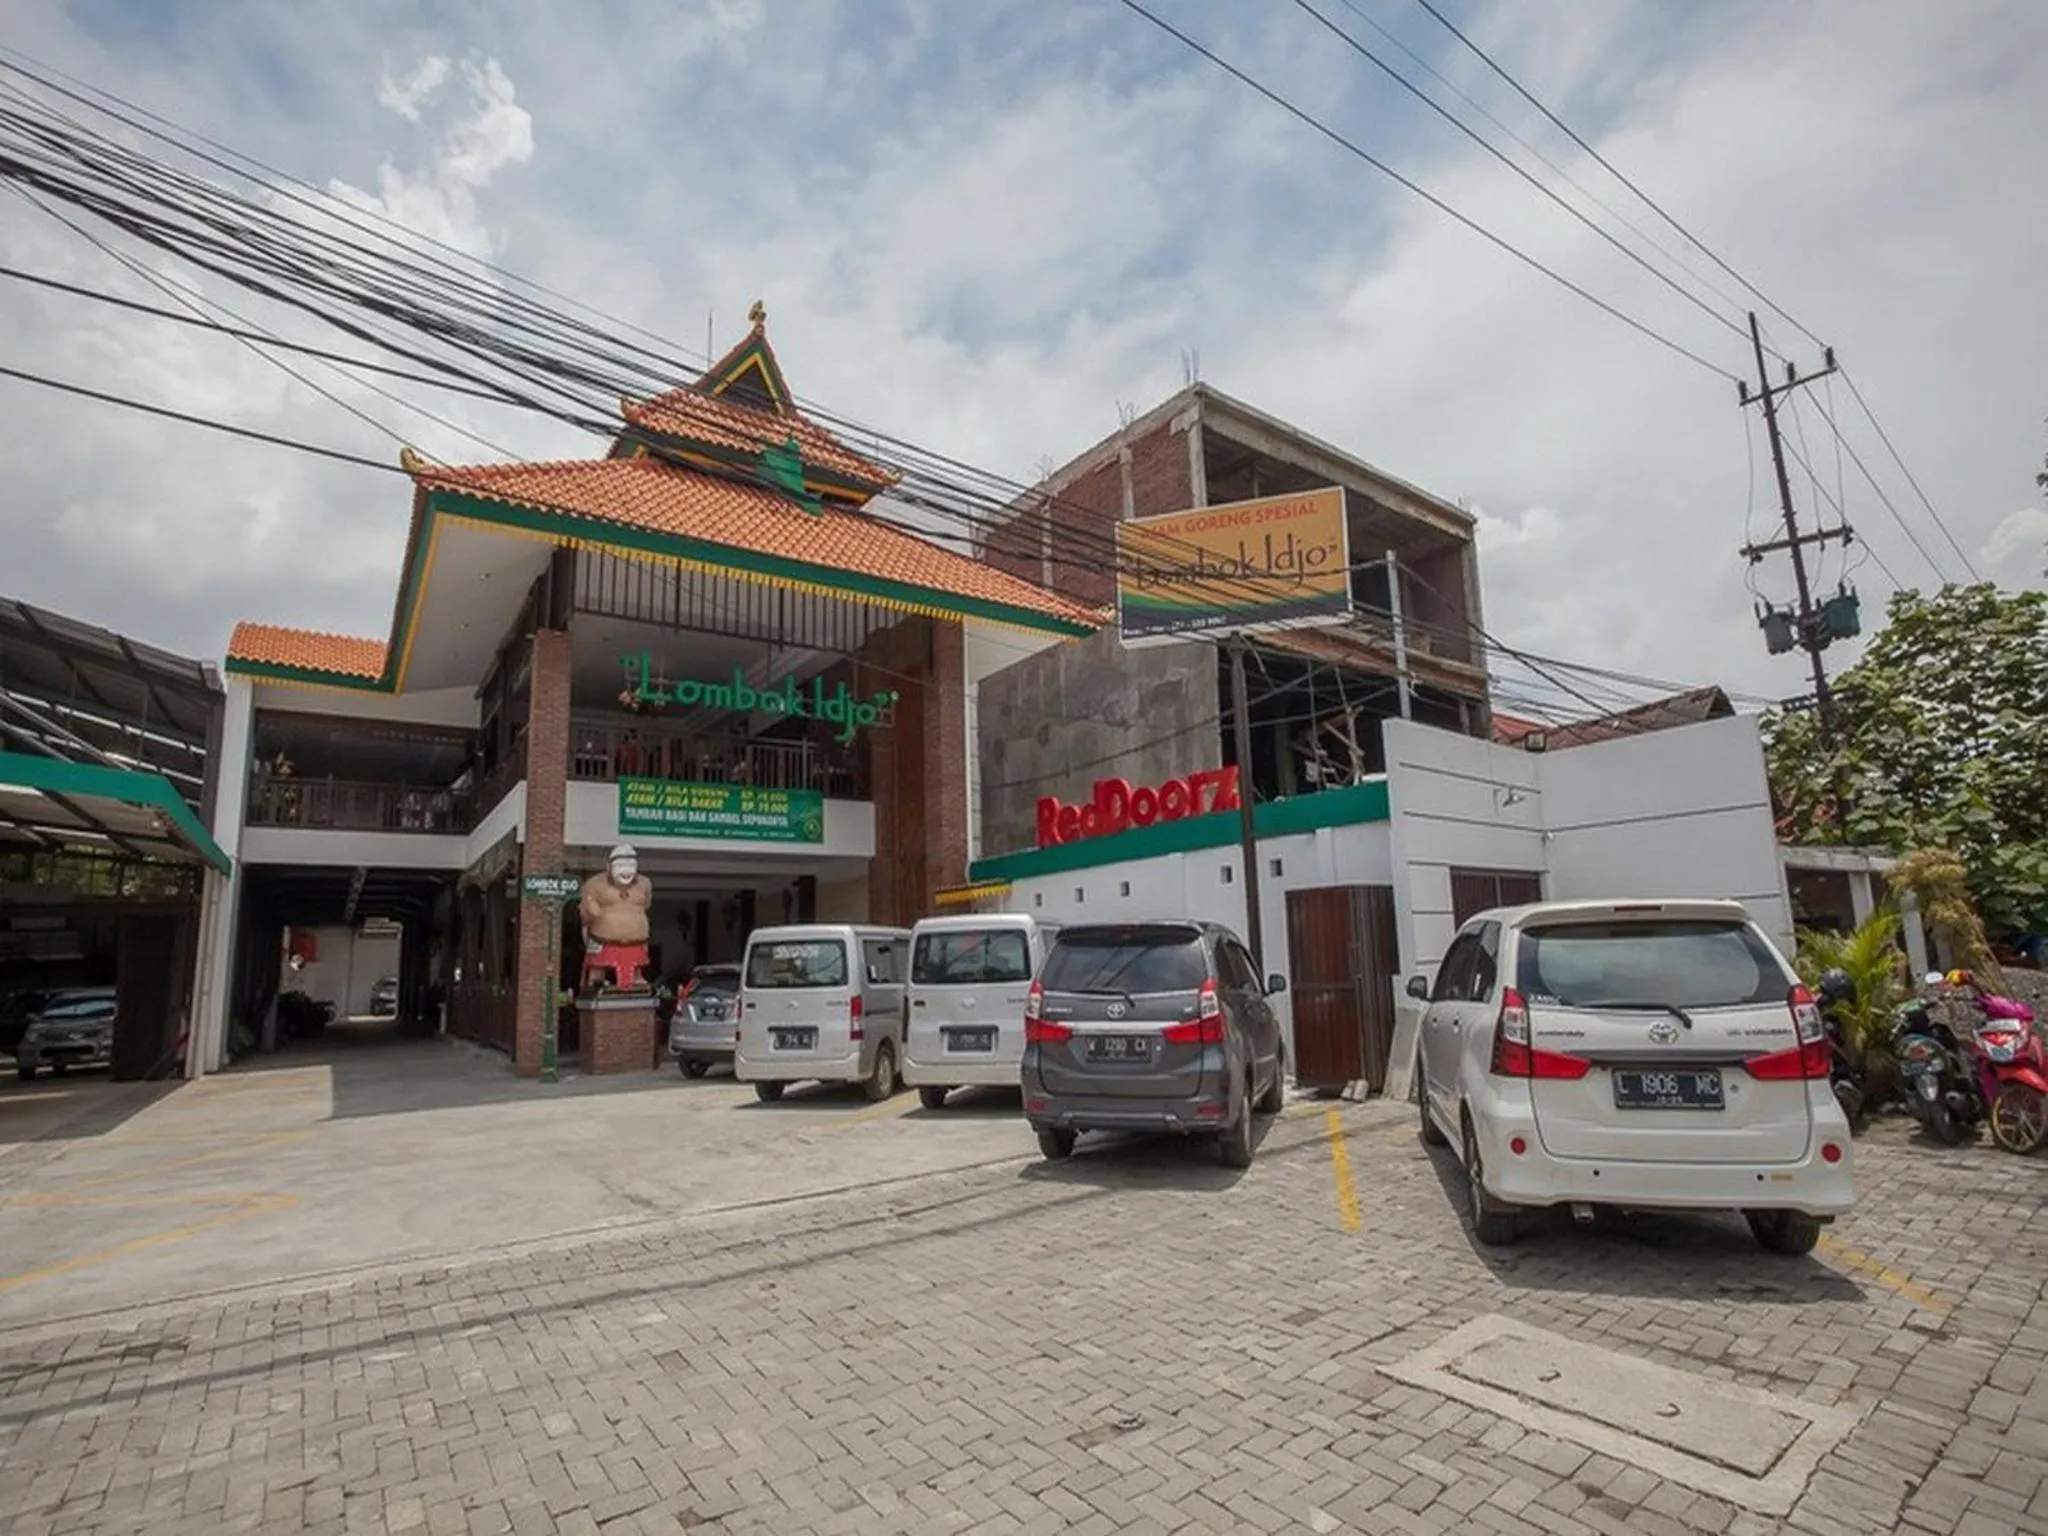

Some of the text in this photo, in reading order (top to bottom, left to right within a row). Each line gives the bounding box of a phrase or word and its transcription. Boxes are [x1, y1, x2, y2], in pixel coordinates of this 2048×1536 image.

[1184, 510, 1250, 532] GORENG
[1256, 500, 1318, 523] SPESIAL
[1037, 765, 1242, 848] RedDoorz
[1640, 1073, 1681, 1095] 1906
